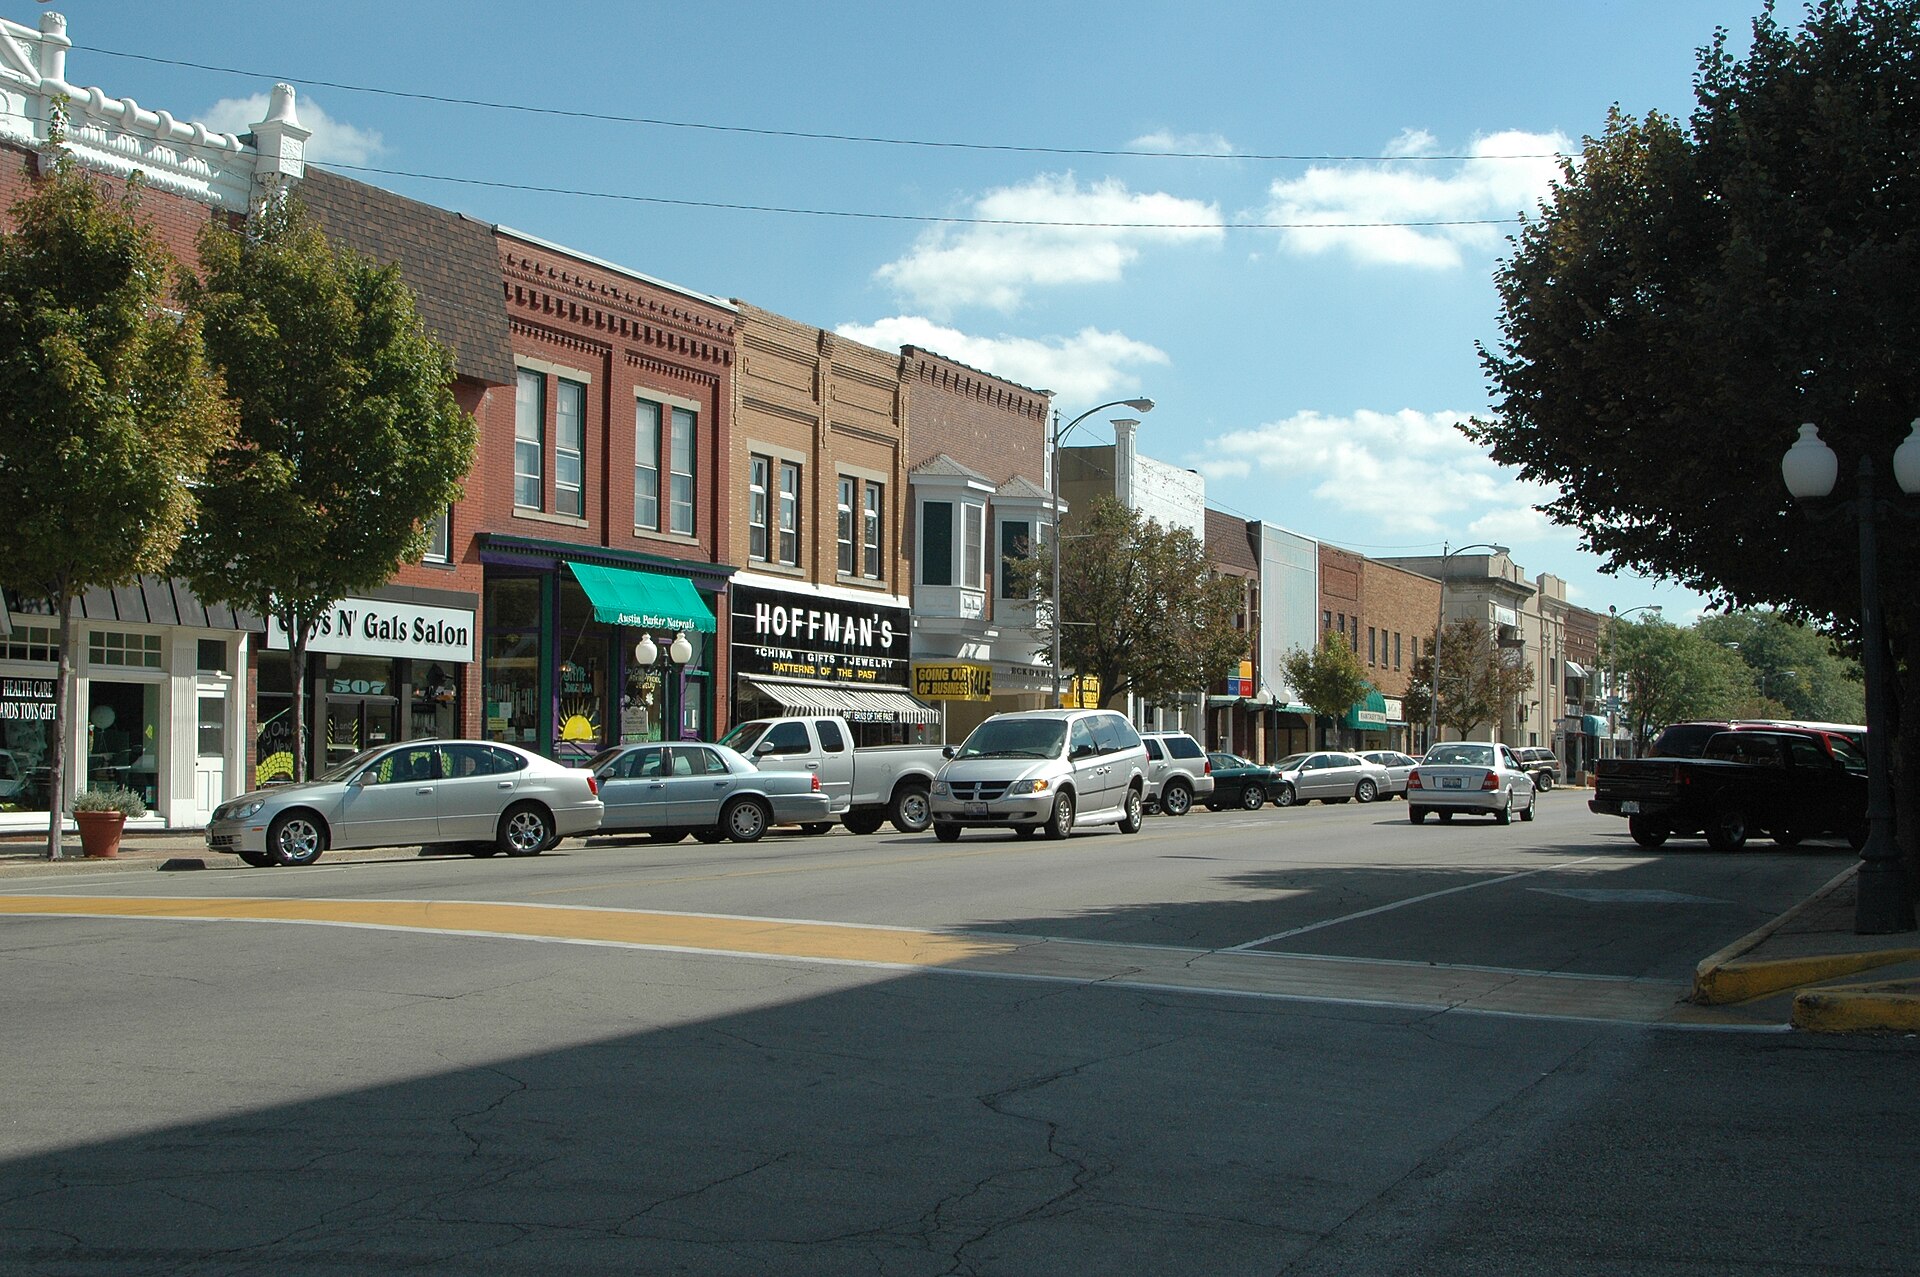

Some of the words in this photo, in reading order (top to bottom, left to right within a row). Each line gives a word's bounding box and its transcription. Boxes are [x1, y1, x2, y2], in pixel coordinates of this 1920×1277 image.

[278, 609, 331, 641] ys
[364, 612, 407, 640] Gals
[412, 616, 467, 646] Salon
[618, 613, 641, 624] Austin
[643, 614, 666, 627] Parker
[667, 617, 695, 629] Naturals
[756, 603, 893, 648] HOFFMAN'S
[760, 648, 793, 659] CHINA
[808, 653, 835, 664] GIFTS
[849, 656, 893, 668] JEWELRY
[772, 662, 816, 675] PATTERNS
[821, 667, 832, 676] OF
[837, 668, 853, 678] THE
[858, 669, 877, 679] PAST
[918, 668, 949, 681] GOING
[951, 668, 967, 681] OUT
[3, 680, 33, 697] HEALTH
[34, 681, 53, 698] CARE
[332, 679, 387, 694] 507
[918, 682, 931, 694] OF
[932, 682, 968, 694] BUSINESS
[20, 703, 39, 720] TOYS
